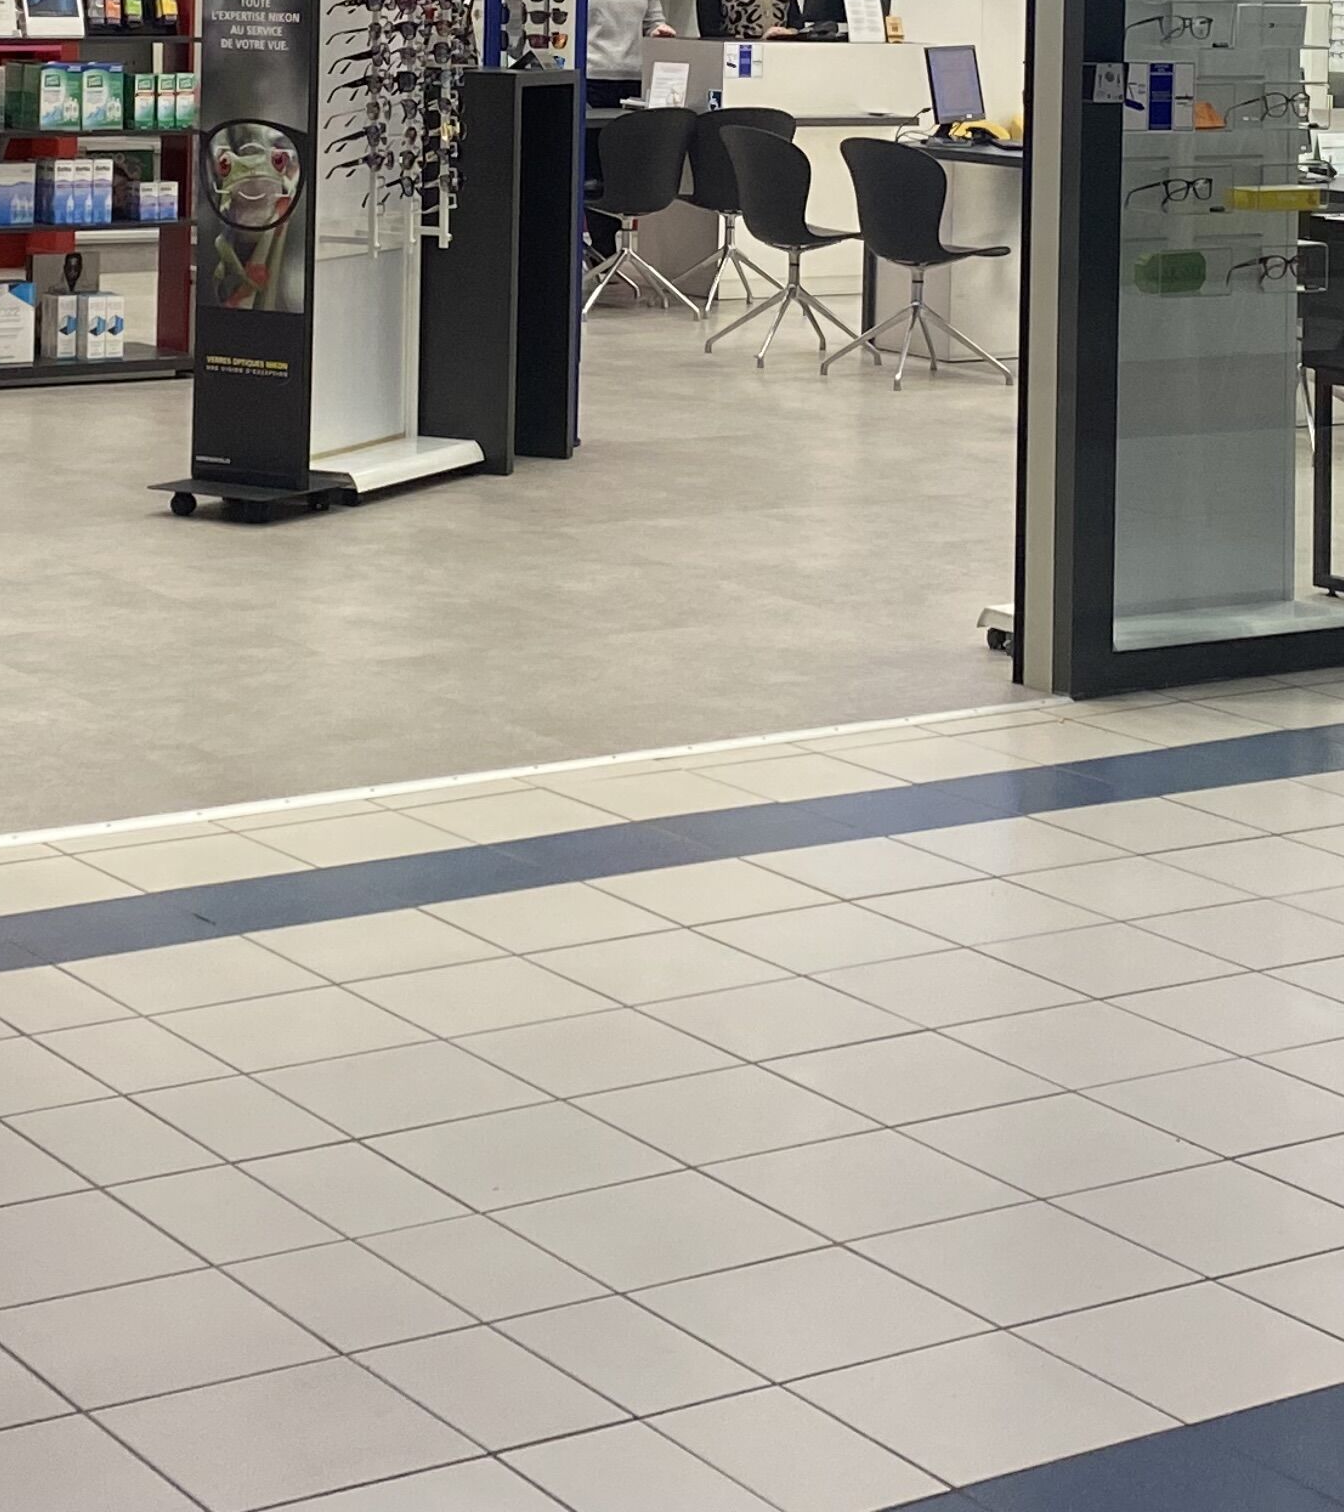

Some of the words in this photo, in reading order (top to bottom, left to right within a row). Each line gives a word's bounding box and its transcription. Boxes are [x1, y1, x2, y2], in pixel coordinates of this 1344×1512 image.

[211, 10, 266, 22] L'EXPERTISE
[268, 12, 300, 23] NIKON
[230, 25, 244, 35] AU
[246, 25, 283, 37] SERVICE
[220, 39, 233, 49] DE
[235, 39, 266, 50] VOTRE
